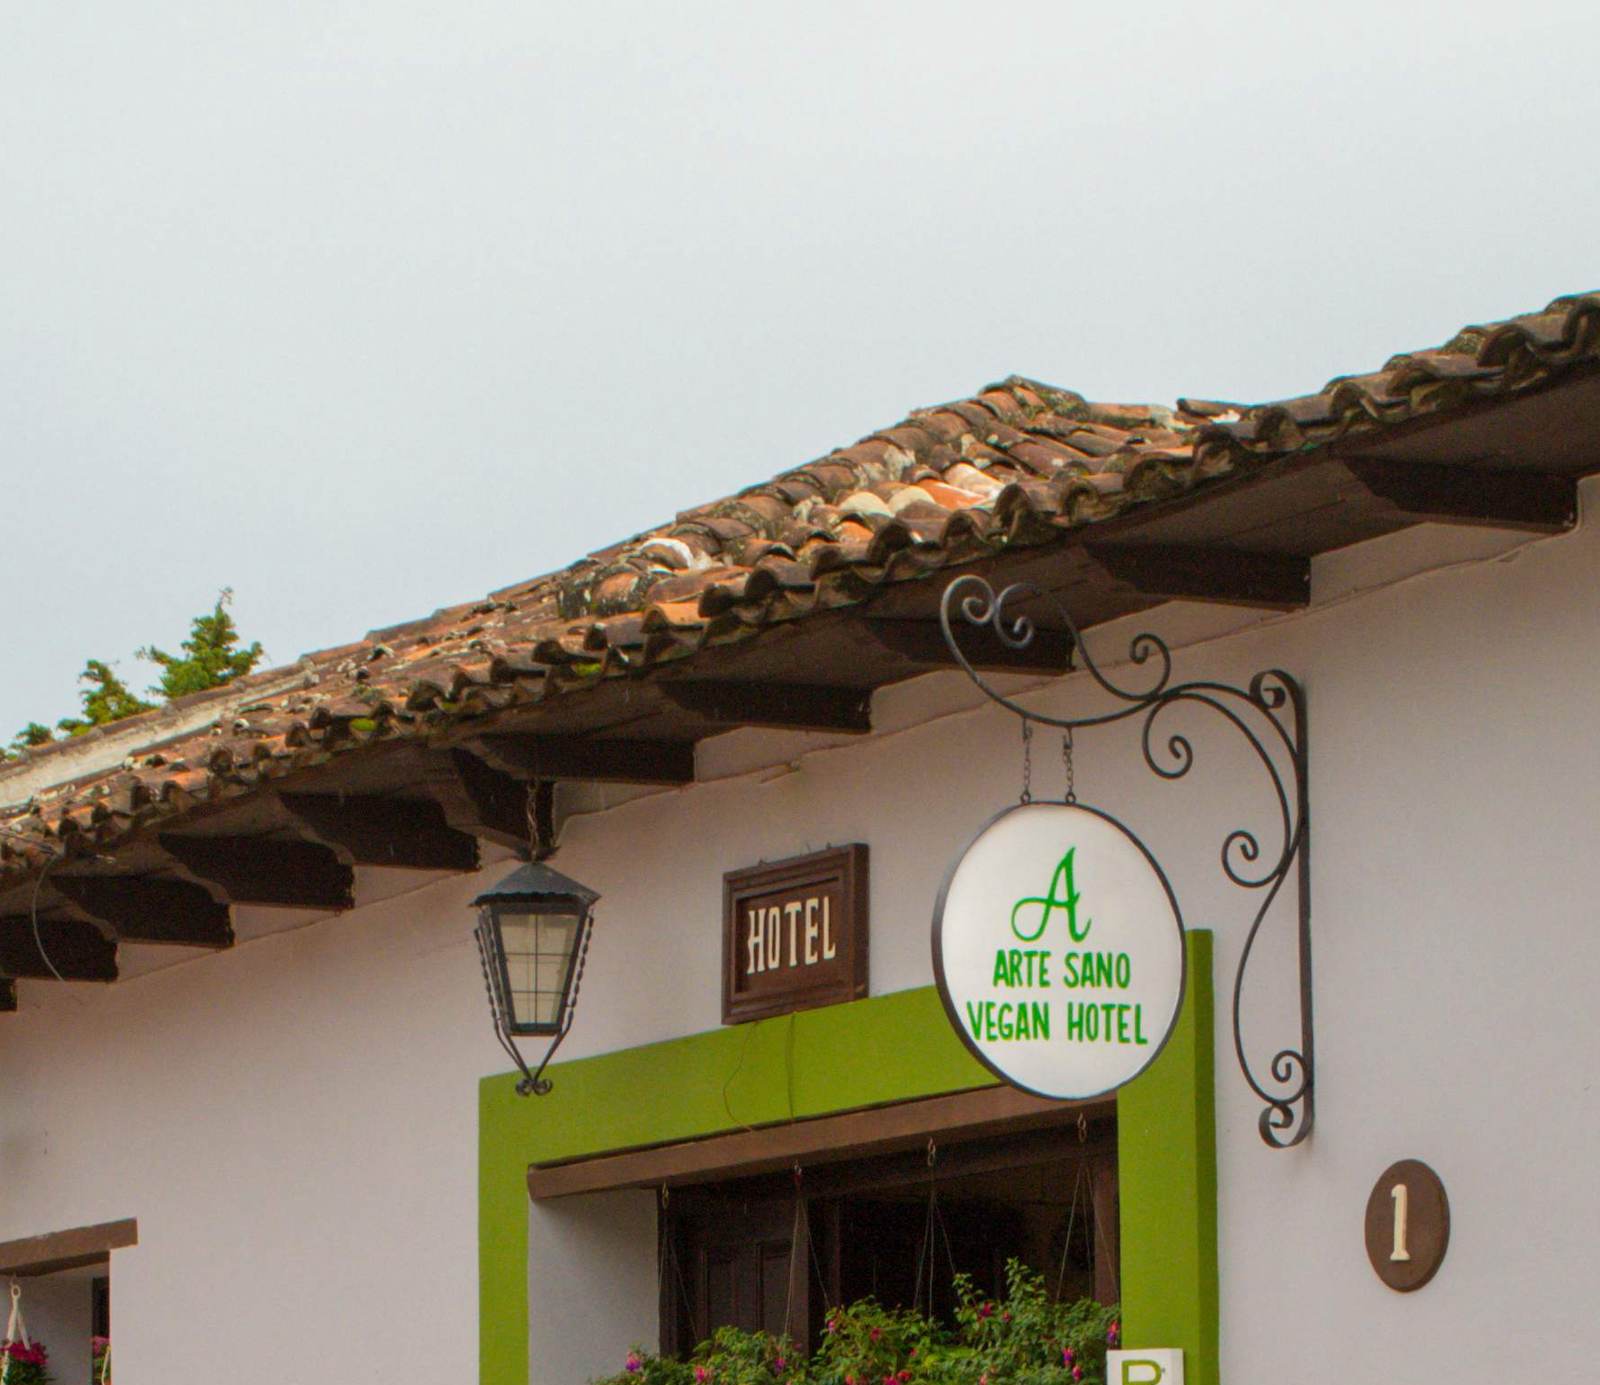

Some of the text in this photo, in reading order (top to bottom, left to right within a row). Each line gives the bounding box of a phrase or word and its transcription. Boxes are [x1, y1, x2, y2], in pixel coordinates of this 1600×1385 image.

[1011, 846, 1092, 942] A
[747, 896, 836, 974] HOTEL
[992, 949, 1131, 989] ARTE SANO
[966, 1000, 1148, 1045] VEGAN HOTEL
[1390, 1183, 1411, 1261] 1
